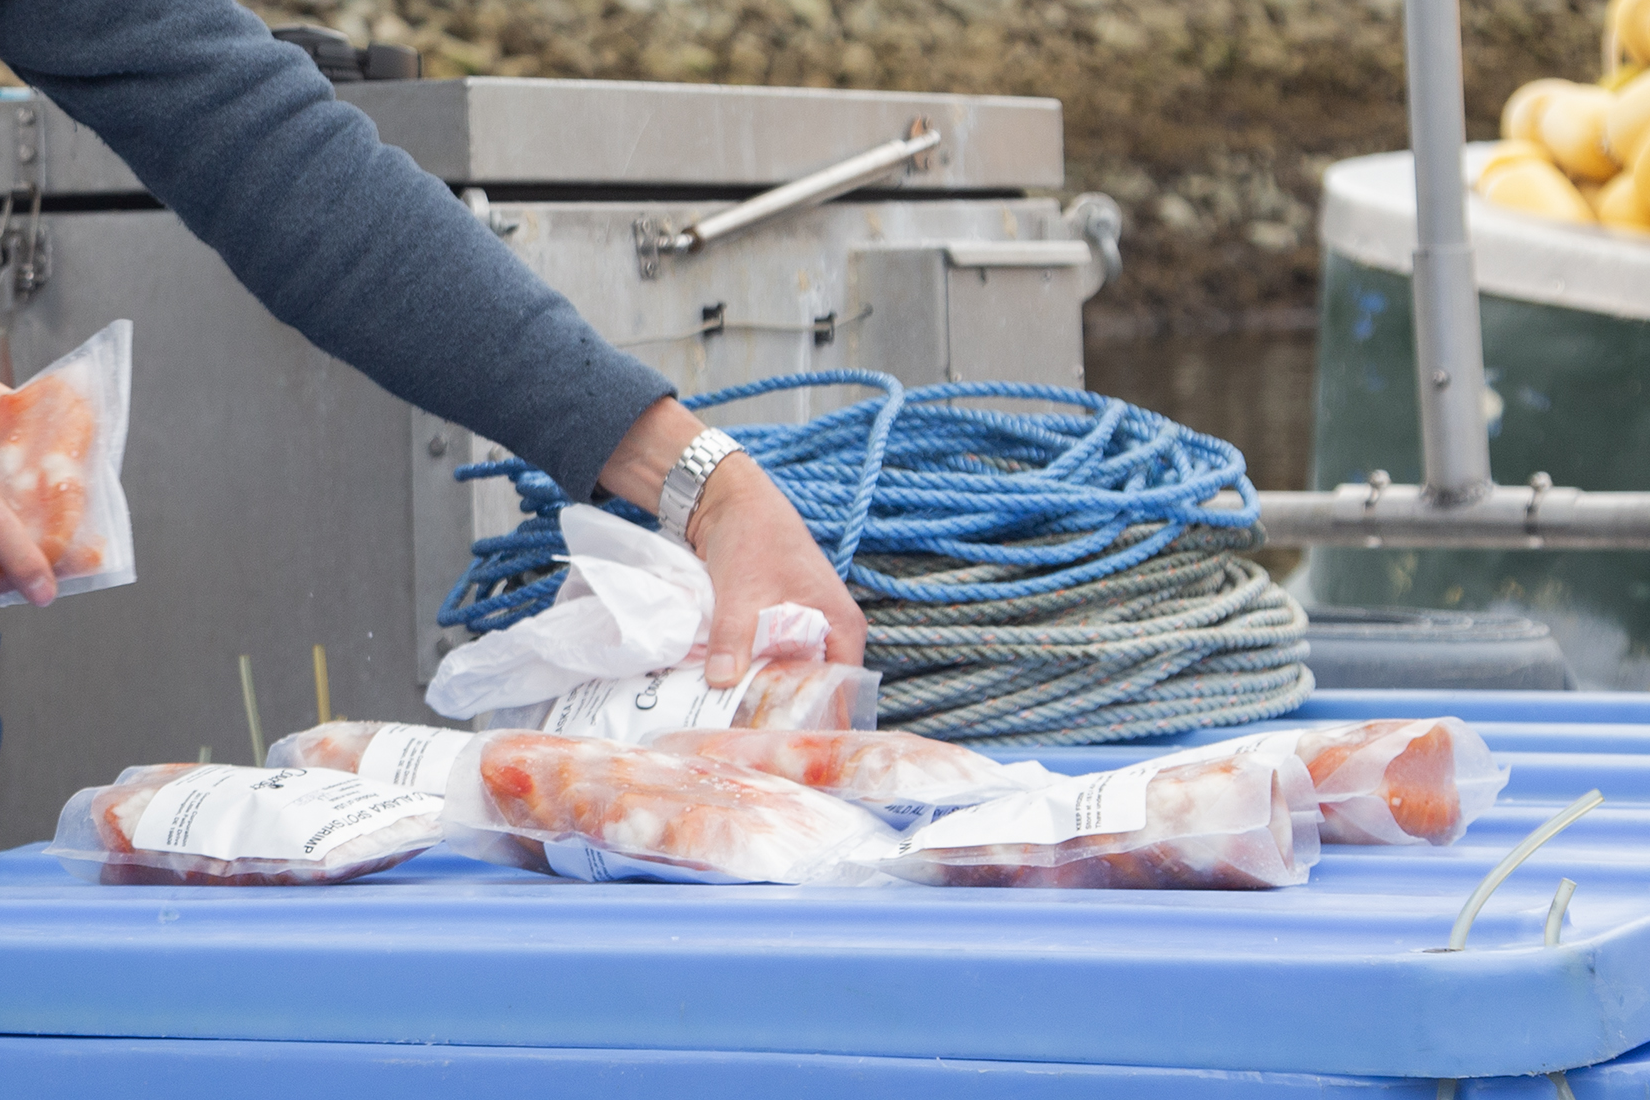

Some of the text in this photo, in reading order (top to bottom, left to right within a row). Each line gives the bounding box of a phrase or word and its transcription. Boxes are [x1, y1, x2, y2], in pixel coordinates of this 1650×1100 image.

[368, 794, 413, 814] ALASKA
[342, 810, 372, 826] SPOT
[305, 819, 345, 854] SHRIMP
